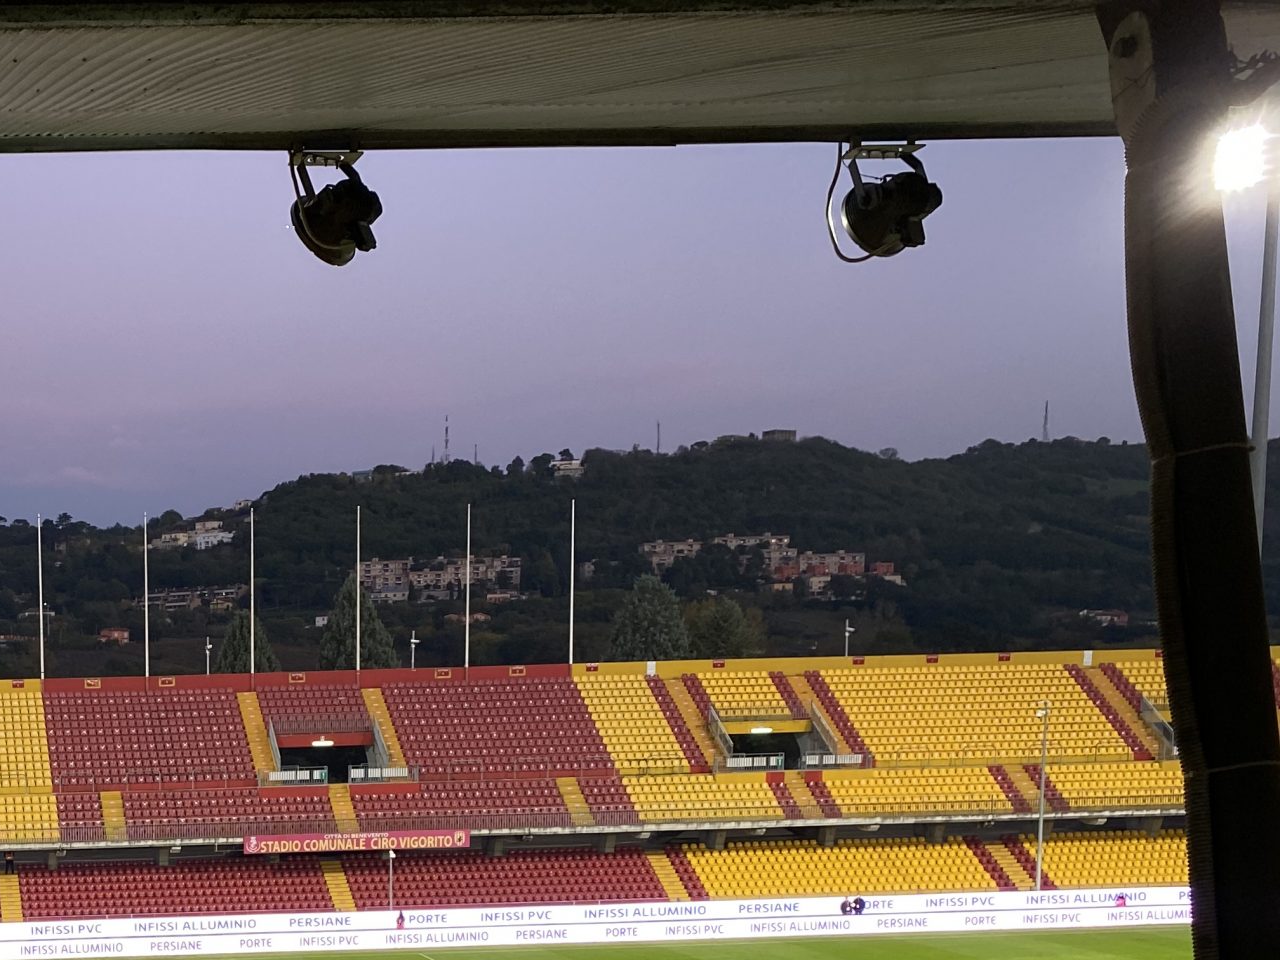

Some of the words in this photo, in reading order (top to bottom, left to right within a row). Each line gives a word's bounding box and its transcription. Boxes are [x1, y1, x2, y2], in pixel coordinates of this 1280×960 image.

[260, 840, 301, 853] STADIO
[303, 838, 366, 852] COMUNALE
[371, 837, 396, 850] CIRO
[399, 835, 453, 849] VIGORITO
[20, 944, 58, 956] INFISSI
[61, 942, 124, 954] ALLUMINIO
[150, 940, 202, 951] PERSIANE
[240, 936, 272, 948] PORTE
[299, 935, 336, 947] INFISSI
[338, 934, 360, 946] PVC
[385, 932, 423, 945] INFISSI
[425, 931, 489, 943] ALLUMINIO
[516, 929, 568, 940] PERSIANE
[606, 926, 638, 937] PORTE
[665, 926, 701, 936] INFISSI
[704, 924, 724, 934] PVC
[750, 922, 786, 933] INFISSI
[789, 920, 850, 931] ALLUMINIO
[877, 917, 928, 928] PERSIANE
[964, 916, 996, 926] PORTE
[1022, 914, 1059, 924] INFISSI
[1062, 913, 1081, 923] PVC
[1108, 911, 1143, 921] INFISSI
[31, 925, 74, 936] INFISSI
[78, 924, 102, 934] PVC
[134, 921, 178, 932] INFISSI
[182, 918, 257, 931] ALLUMINIO
[289, 916, 352, 928] PERSIANE
[409, 912, 448, 924] PORTE
[481, 911, 524, 922] INFISSI
[528, 910, 552, 920] PVC
[584, 908, 628, 919] INFISSI
[633, 905, 707, 917] ALLUMINIO
[738, 902, 800, 914] PERSIANE
[864, 900, 894, 910] ORTE
[926, 896, 968, 908] INFISSI
[972, 896, 995, 906] PVC
[1026, 894, 1070, 906] INFISSI
